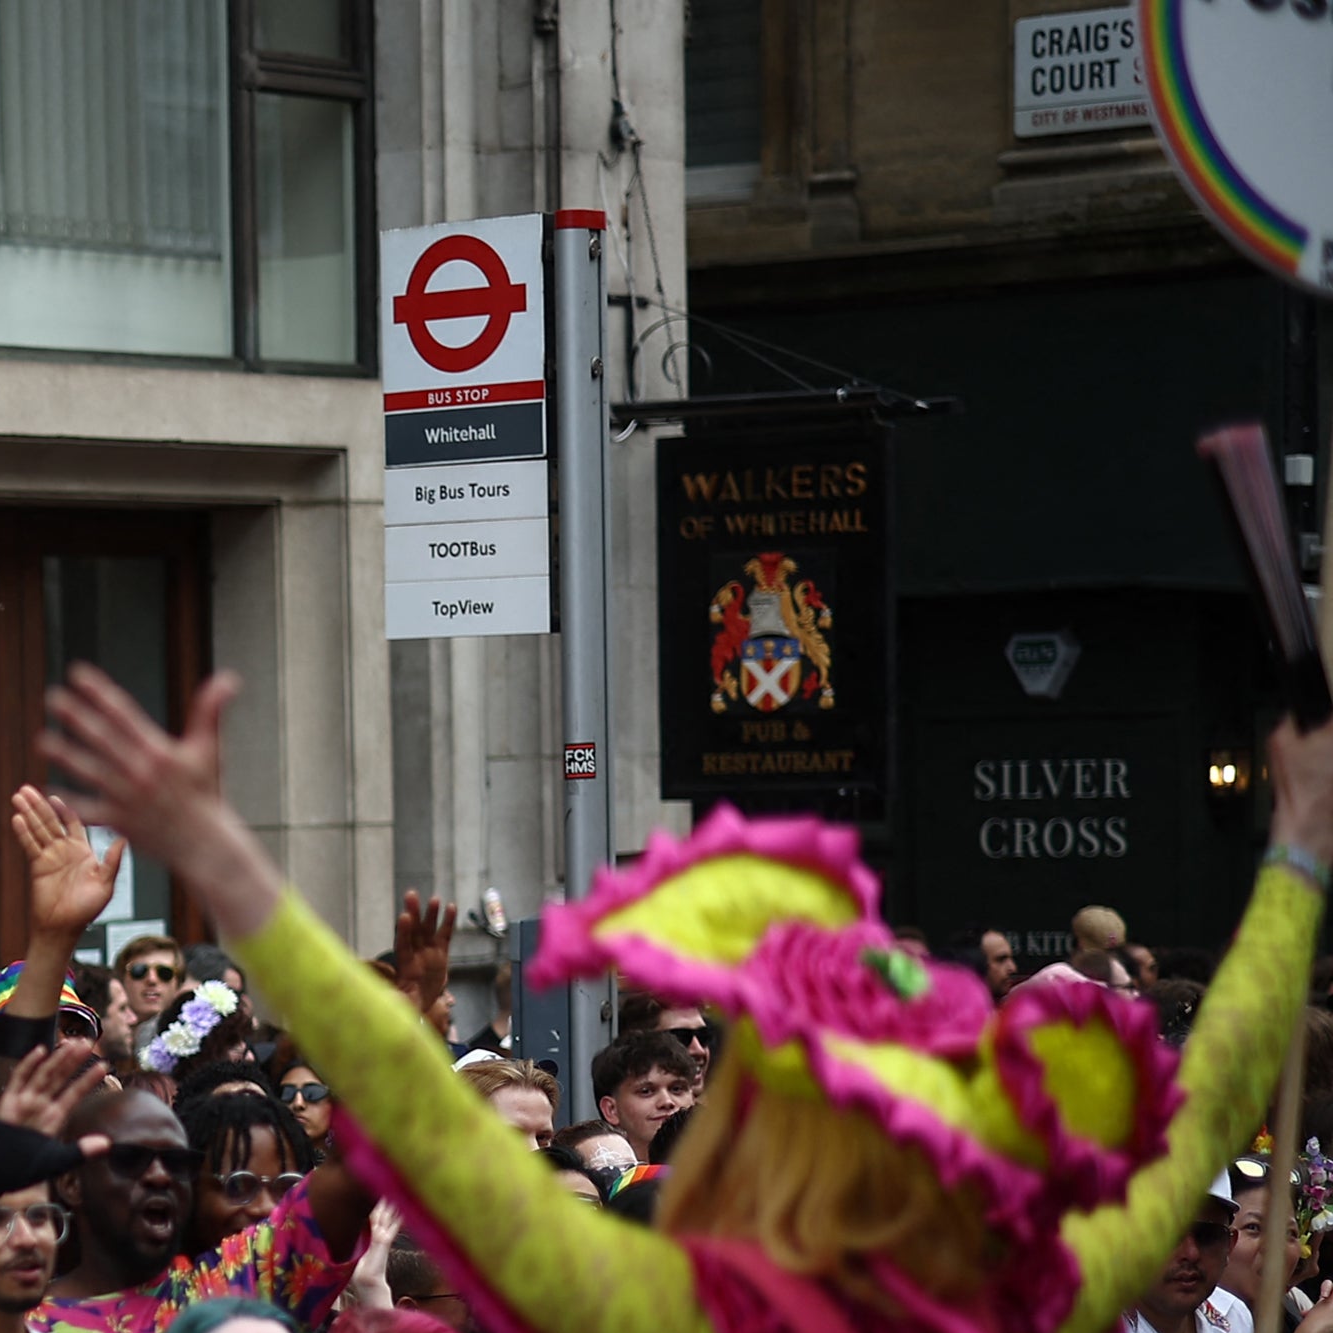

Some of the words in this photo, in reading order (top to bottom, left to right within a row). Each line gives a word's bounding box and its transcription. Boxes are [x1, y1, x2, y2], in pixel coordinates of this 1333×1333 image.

[1031, 20, 1134, 58] CRAIG'S
[1031, 57, 1121, 96] COURT
[1031, 110, 1058, 127] CITY
[1063, 109, 1079, 124] OF
[427, 391, 452, 404] BUS
[456, 388, 489, 402] STOP
[424, 424, 496, 444] Whitehall
[682, 461, 868, 503] WALKERS
[415, 486, 436, 504] Big
[439, 485, 465, 500] Bus
[469, 483, 510, 498] Tours
[680, 515, 715, 540] OF
[724, 508, 868, 536] WHITEHALL
[429, 541, 496, 558] TOOTBus
[432, 599, 494, 619] TopView
[742, 720, 786, 743] PUB
[792, 720, 812, 742] &
[565, 749, 594, 761] FCK
[702, 751, 854, 775] RESTAURANT
[565, 760, 595, 773] HMS
[974, 758, 1131, 801] SILVER
[980, 816, 1128, 858] CROSS
